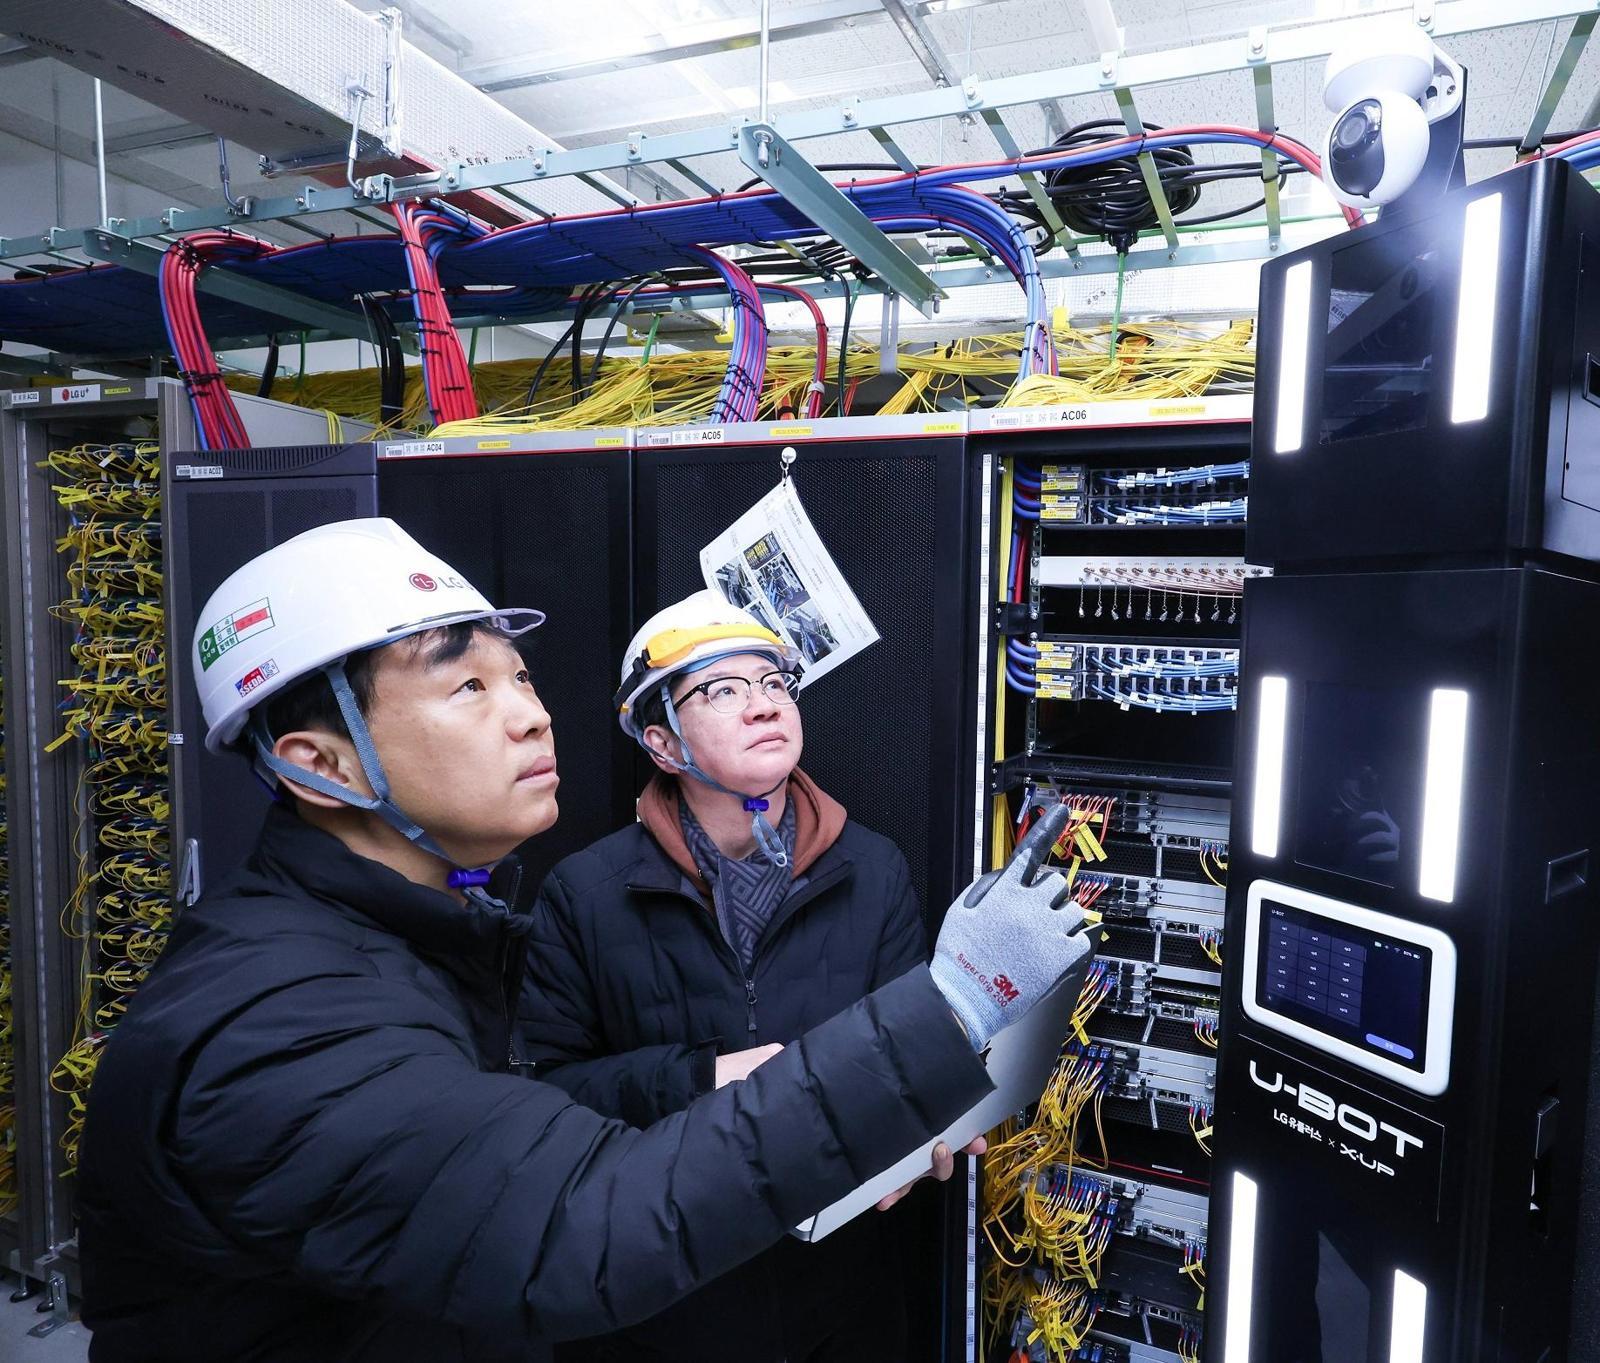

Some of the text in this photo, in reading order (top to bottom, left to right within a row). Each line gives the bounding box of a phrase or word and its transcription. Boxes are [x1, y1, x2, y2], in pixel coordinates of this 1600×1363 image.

[70, 389, 80, 399] LG
[1061, 410, 1087, 421] AC06
[701, 430, 721, 440] AC05
[426, 444, 442, 452] AC04
[957, 952, 1008, 1008] Super Grip 200
[993, 974, 1020, 1003] 3M
[1250, 1059, 1424, 1158] U-BOT
